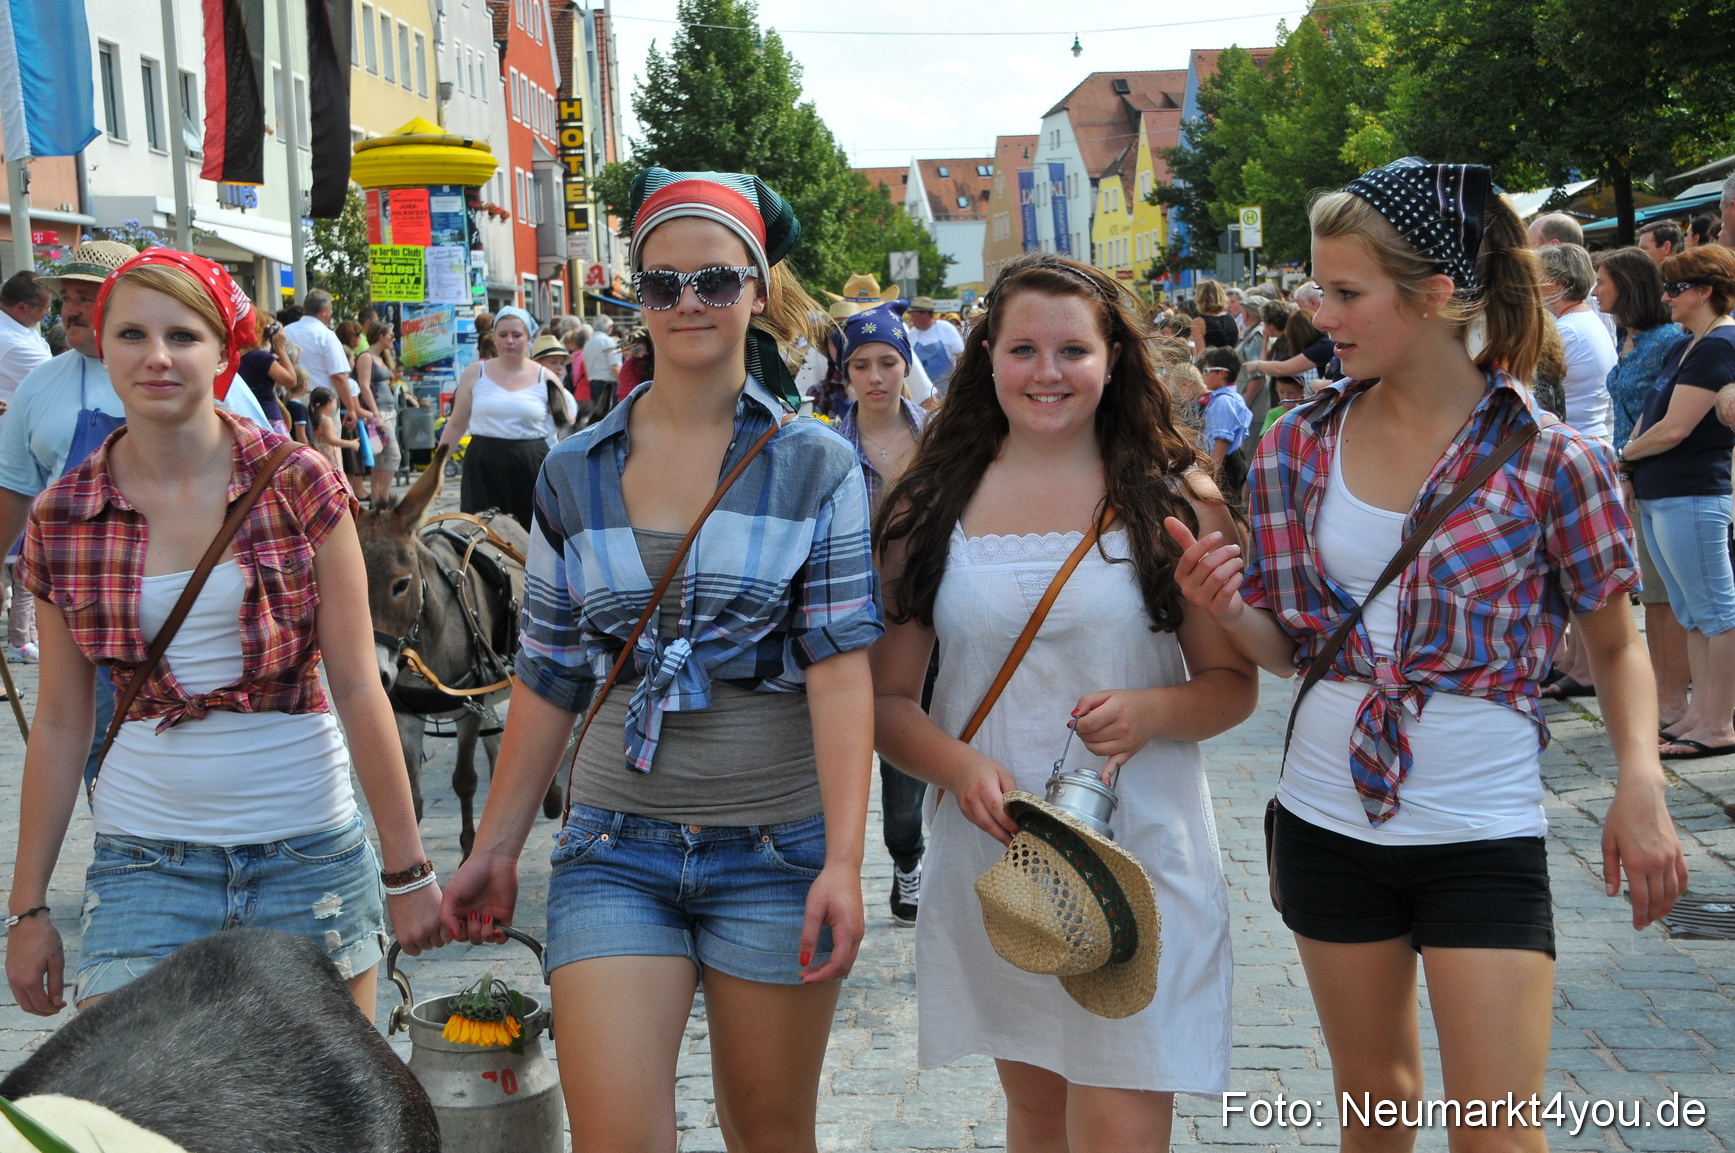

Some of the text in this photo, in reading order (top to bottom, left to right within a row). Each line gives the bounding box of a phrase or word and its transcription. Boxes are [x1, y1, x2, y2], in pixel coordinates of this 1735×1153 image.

[560, 101, 587, 229] HOTEL
[379, 247, 400, 256] Berlin
[402, 247, 421, 257] Club
